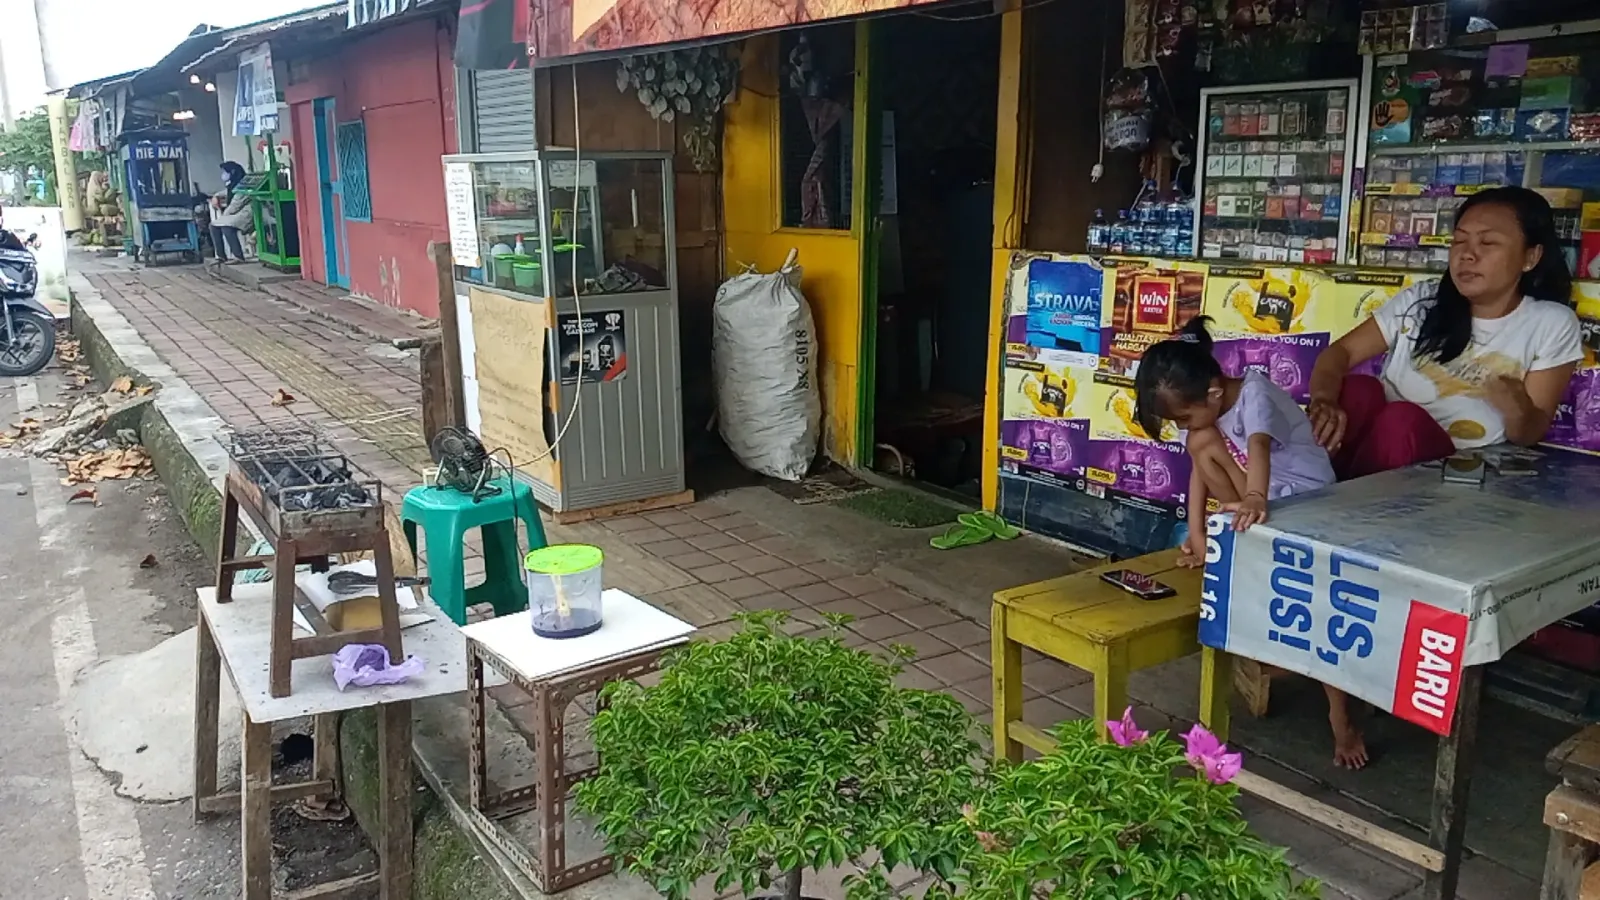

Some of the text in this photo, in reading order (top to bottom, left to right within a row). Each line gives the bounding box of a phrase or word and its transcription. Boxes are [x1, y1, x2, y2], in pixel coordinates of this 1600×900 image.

[135, 145, 184, 159] MIE AYAM
[1034, 292, 1093, 312] STRAVA
[1114, 332, 1154, 345] KUALITAS
[1280, 336, 1299, 345] YOU
[1300, 338, 1314, 347] ON
[1168, 445, 1180, 453] ON
[1268, 536, 1315, 652] GUS!
[1317, 549, 1380, 667] LUS,
[1410, 627, 1457, 719] BARU
